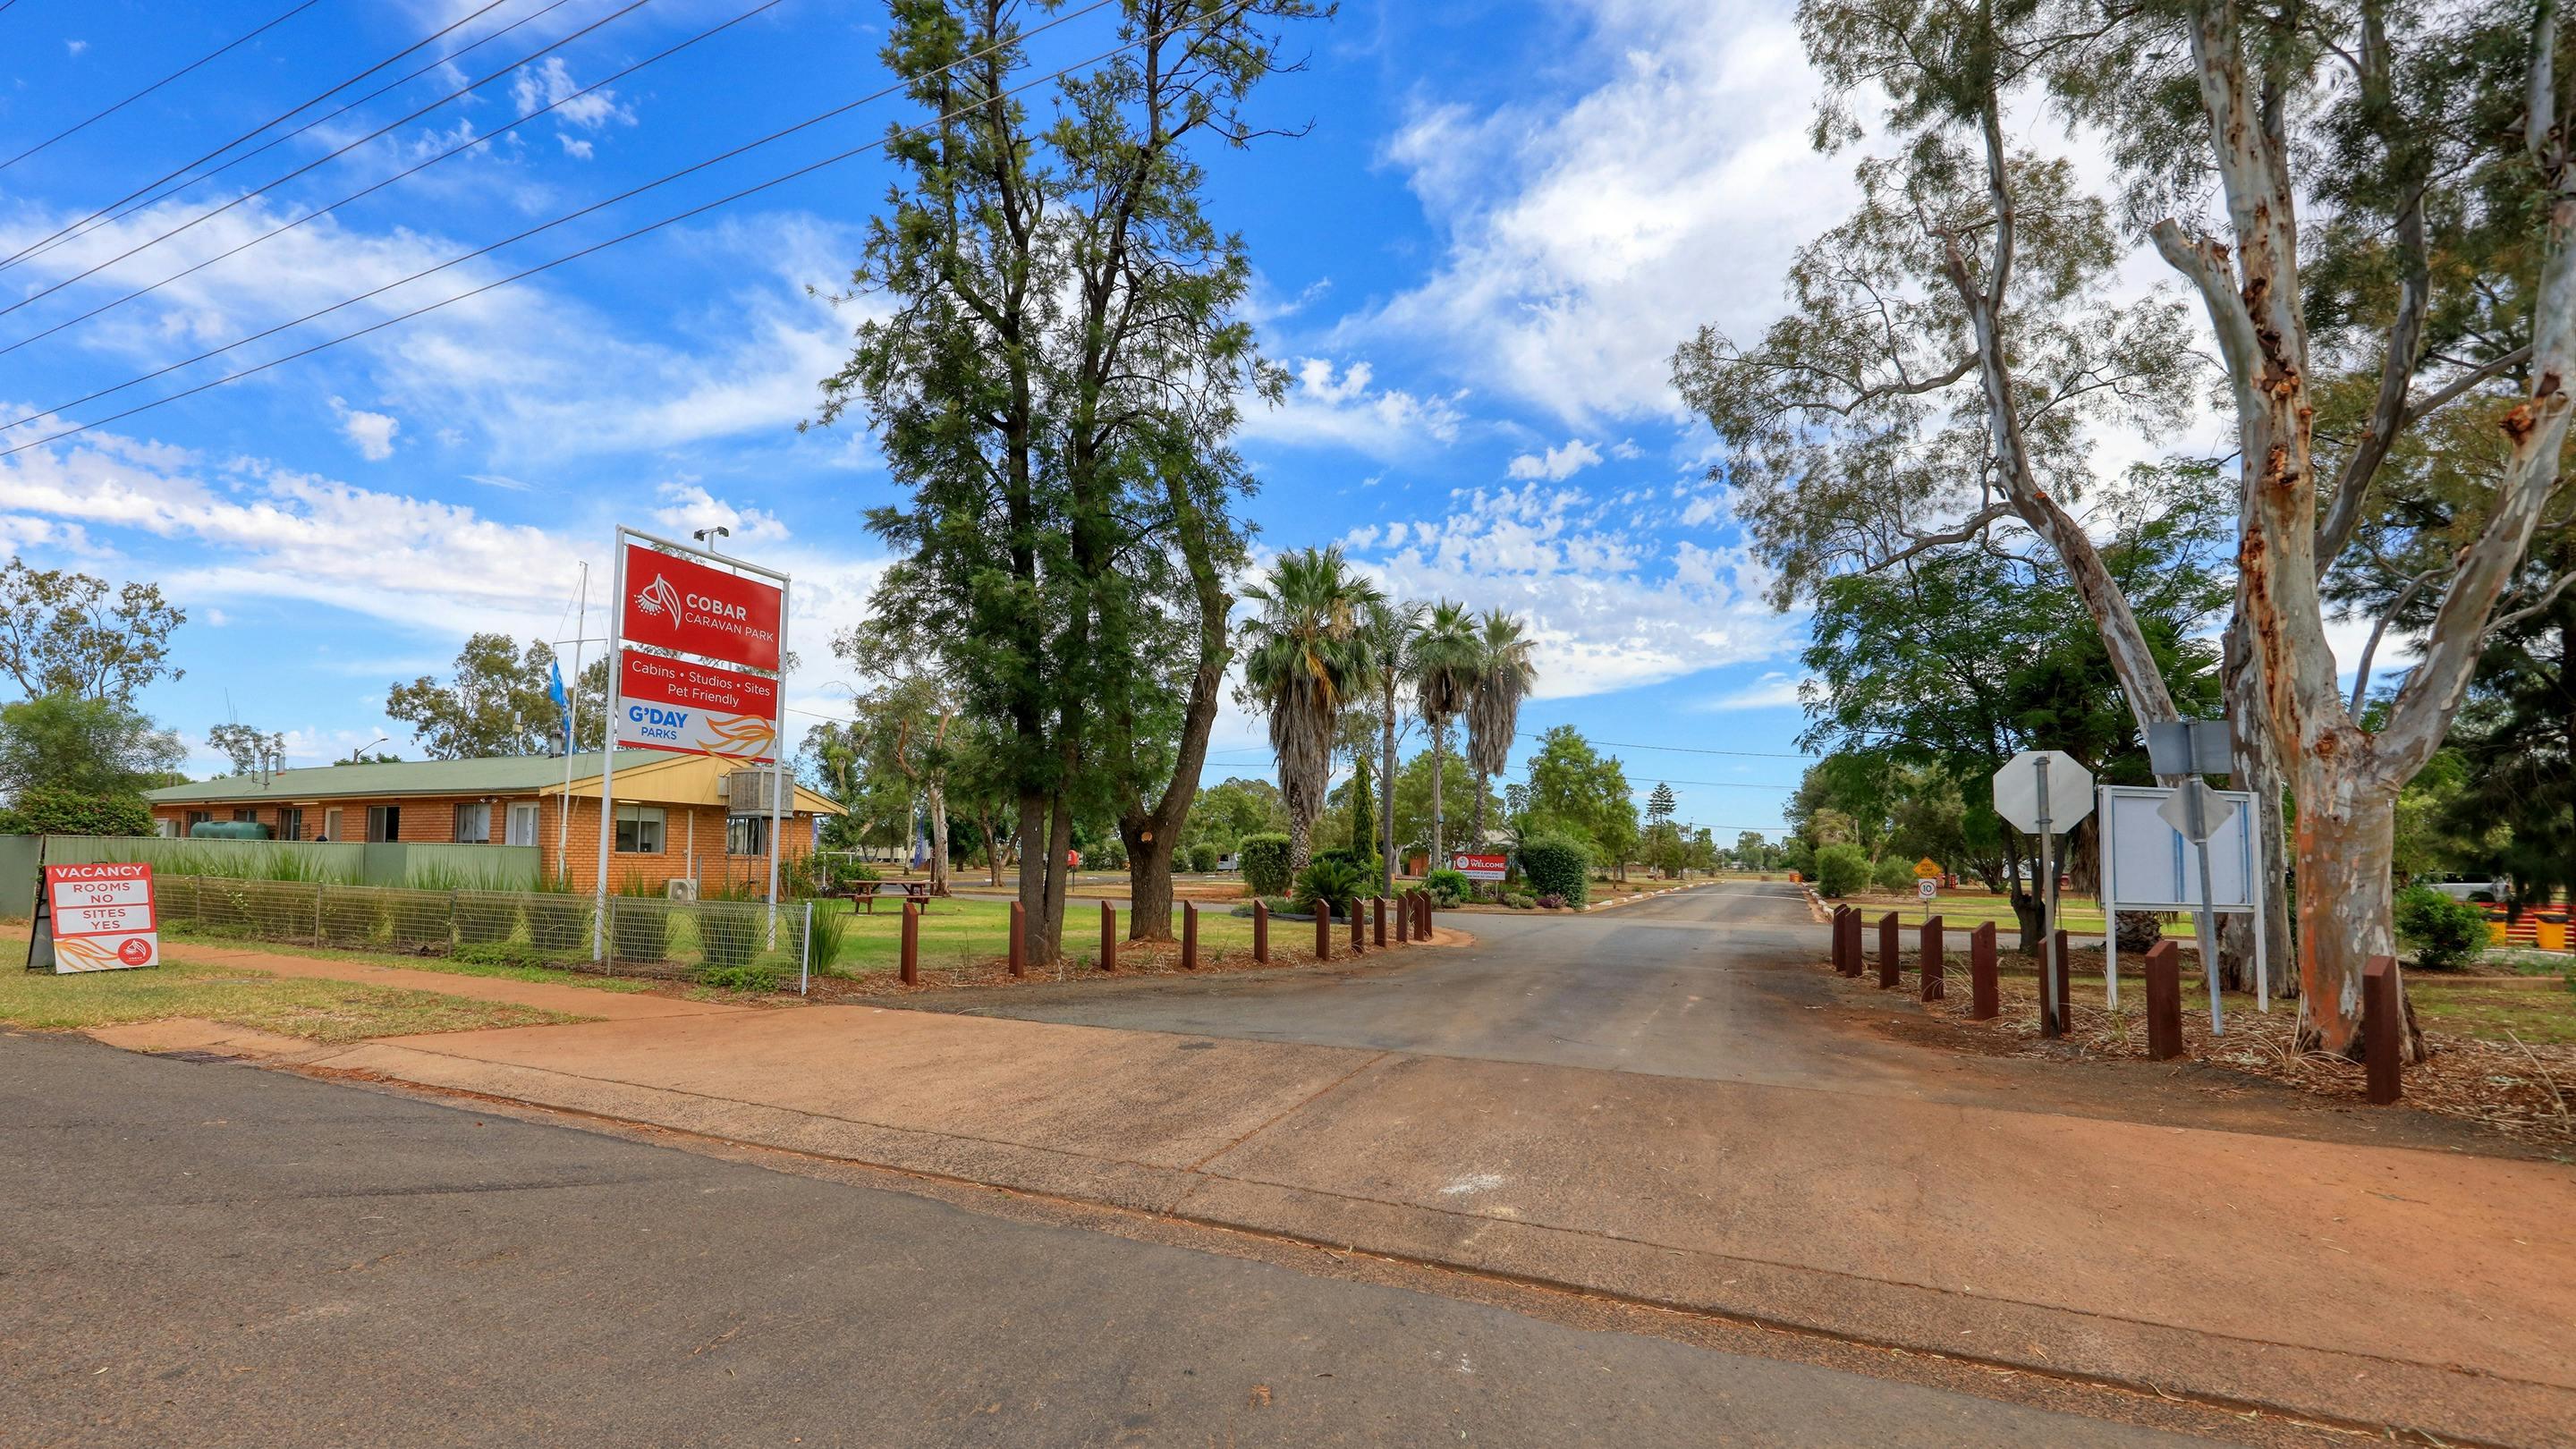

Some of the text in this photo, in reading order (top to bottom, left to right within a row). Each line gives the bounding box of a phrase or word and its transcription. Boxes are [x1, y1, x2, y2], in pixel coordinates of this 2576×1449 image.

[686, 593, 747, 622] COBAR
[684, 613, 774, 642] CARAVAN PARK
[631, 660, 770, 697] Cabins Studios Sites
[668, 684, 740, 708] Pet Friendly
[641, 726, 677, 741] PARKS
[55, 865, 143, 878] VACANCY
[73, 882, 131, 893] ROOMS
[1923, 885, 1932, 893] 10
[90, 894, 114, 903] NO
[82, 908, 126, 919] SITES
[90, 920, 121, 930] YES
